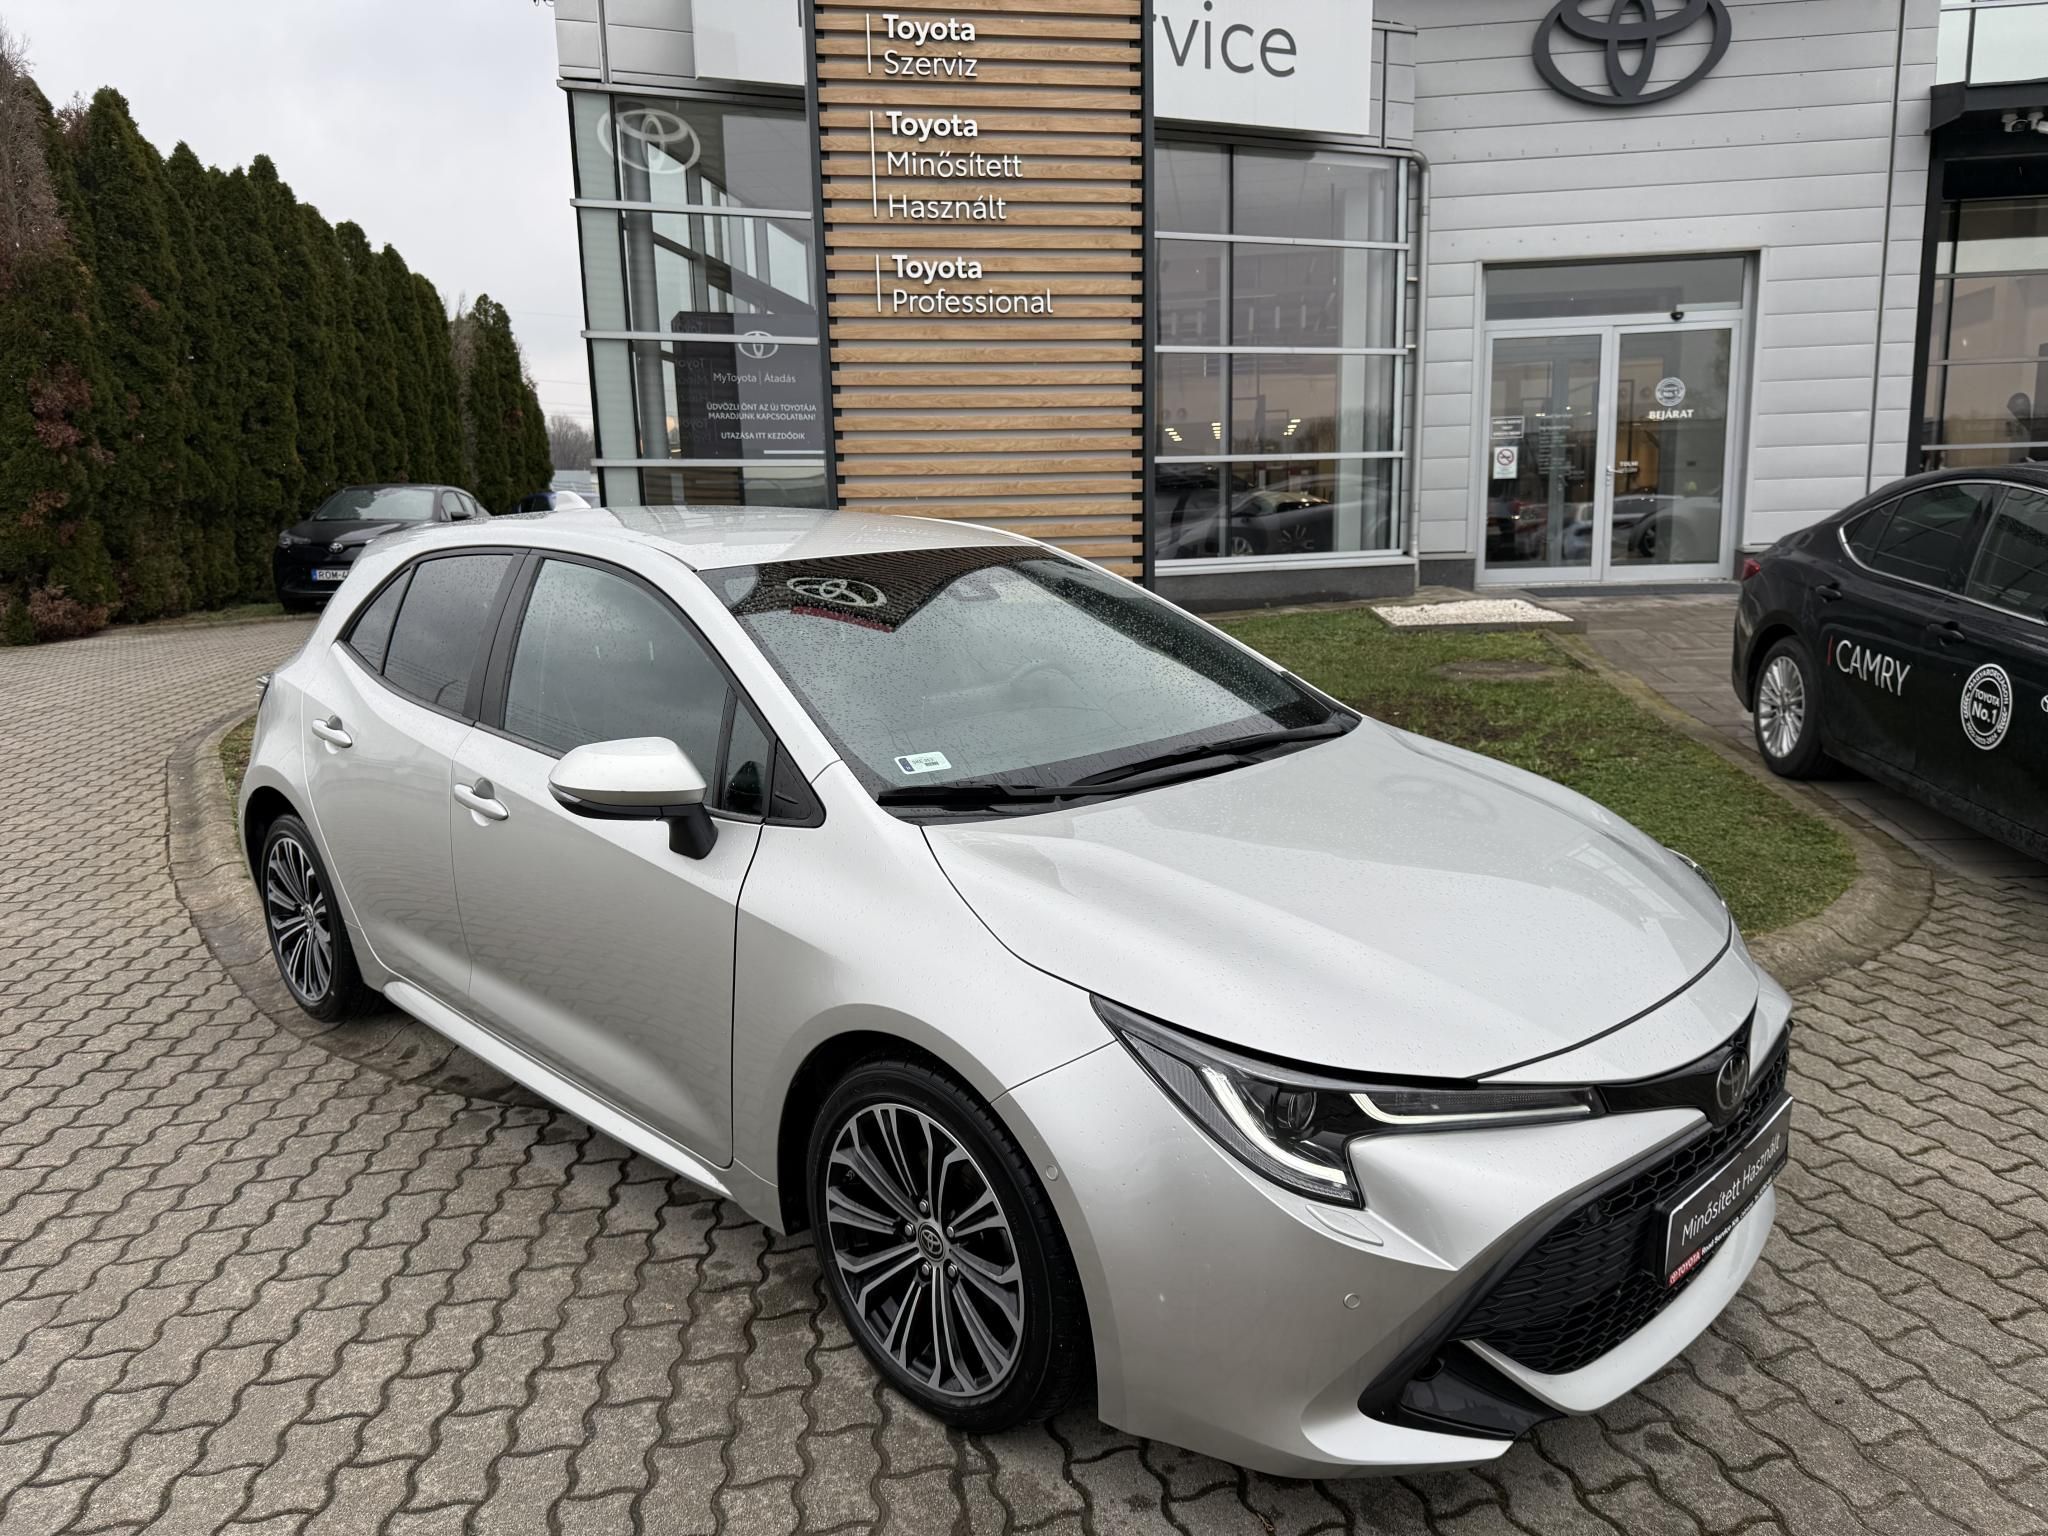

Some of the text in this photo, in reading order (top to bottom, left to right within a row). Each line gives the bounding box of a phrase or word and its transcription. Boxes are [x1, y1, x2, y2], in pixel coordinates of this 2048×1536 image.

[883, 14, 976, 45] Toyota
[1153, 0, 1297, 77] vice
[883, 50, 978, 78] Szerviz
[886, 111, 979, 142] Toyota
[887, 149, 1023, 178] Minősített
[889, 193, 1007, 221] Használt
[892, 255, 983, 284] Toyota
[892, 288, 1054, 315] Professional
[713, 371, 796, 384] MyToyota Átadás
[759, 403, 769, 411] AZ
[1648, 408, 1694, 421] BEJÁRAT
[318, 571, 350, 579] ROM-4
[1836, 639, 1912, 697] CAMRY
[1975, 689, 2000, 707] TOYOTA
[1972, 701, 1997, 725] No.1
[1682, 1178, 1740, 1247] Minősített
[1742, 1132, 1780, 1190] Használt
[1677, 1250, 1701, 1278] TOYOTA
